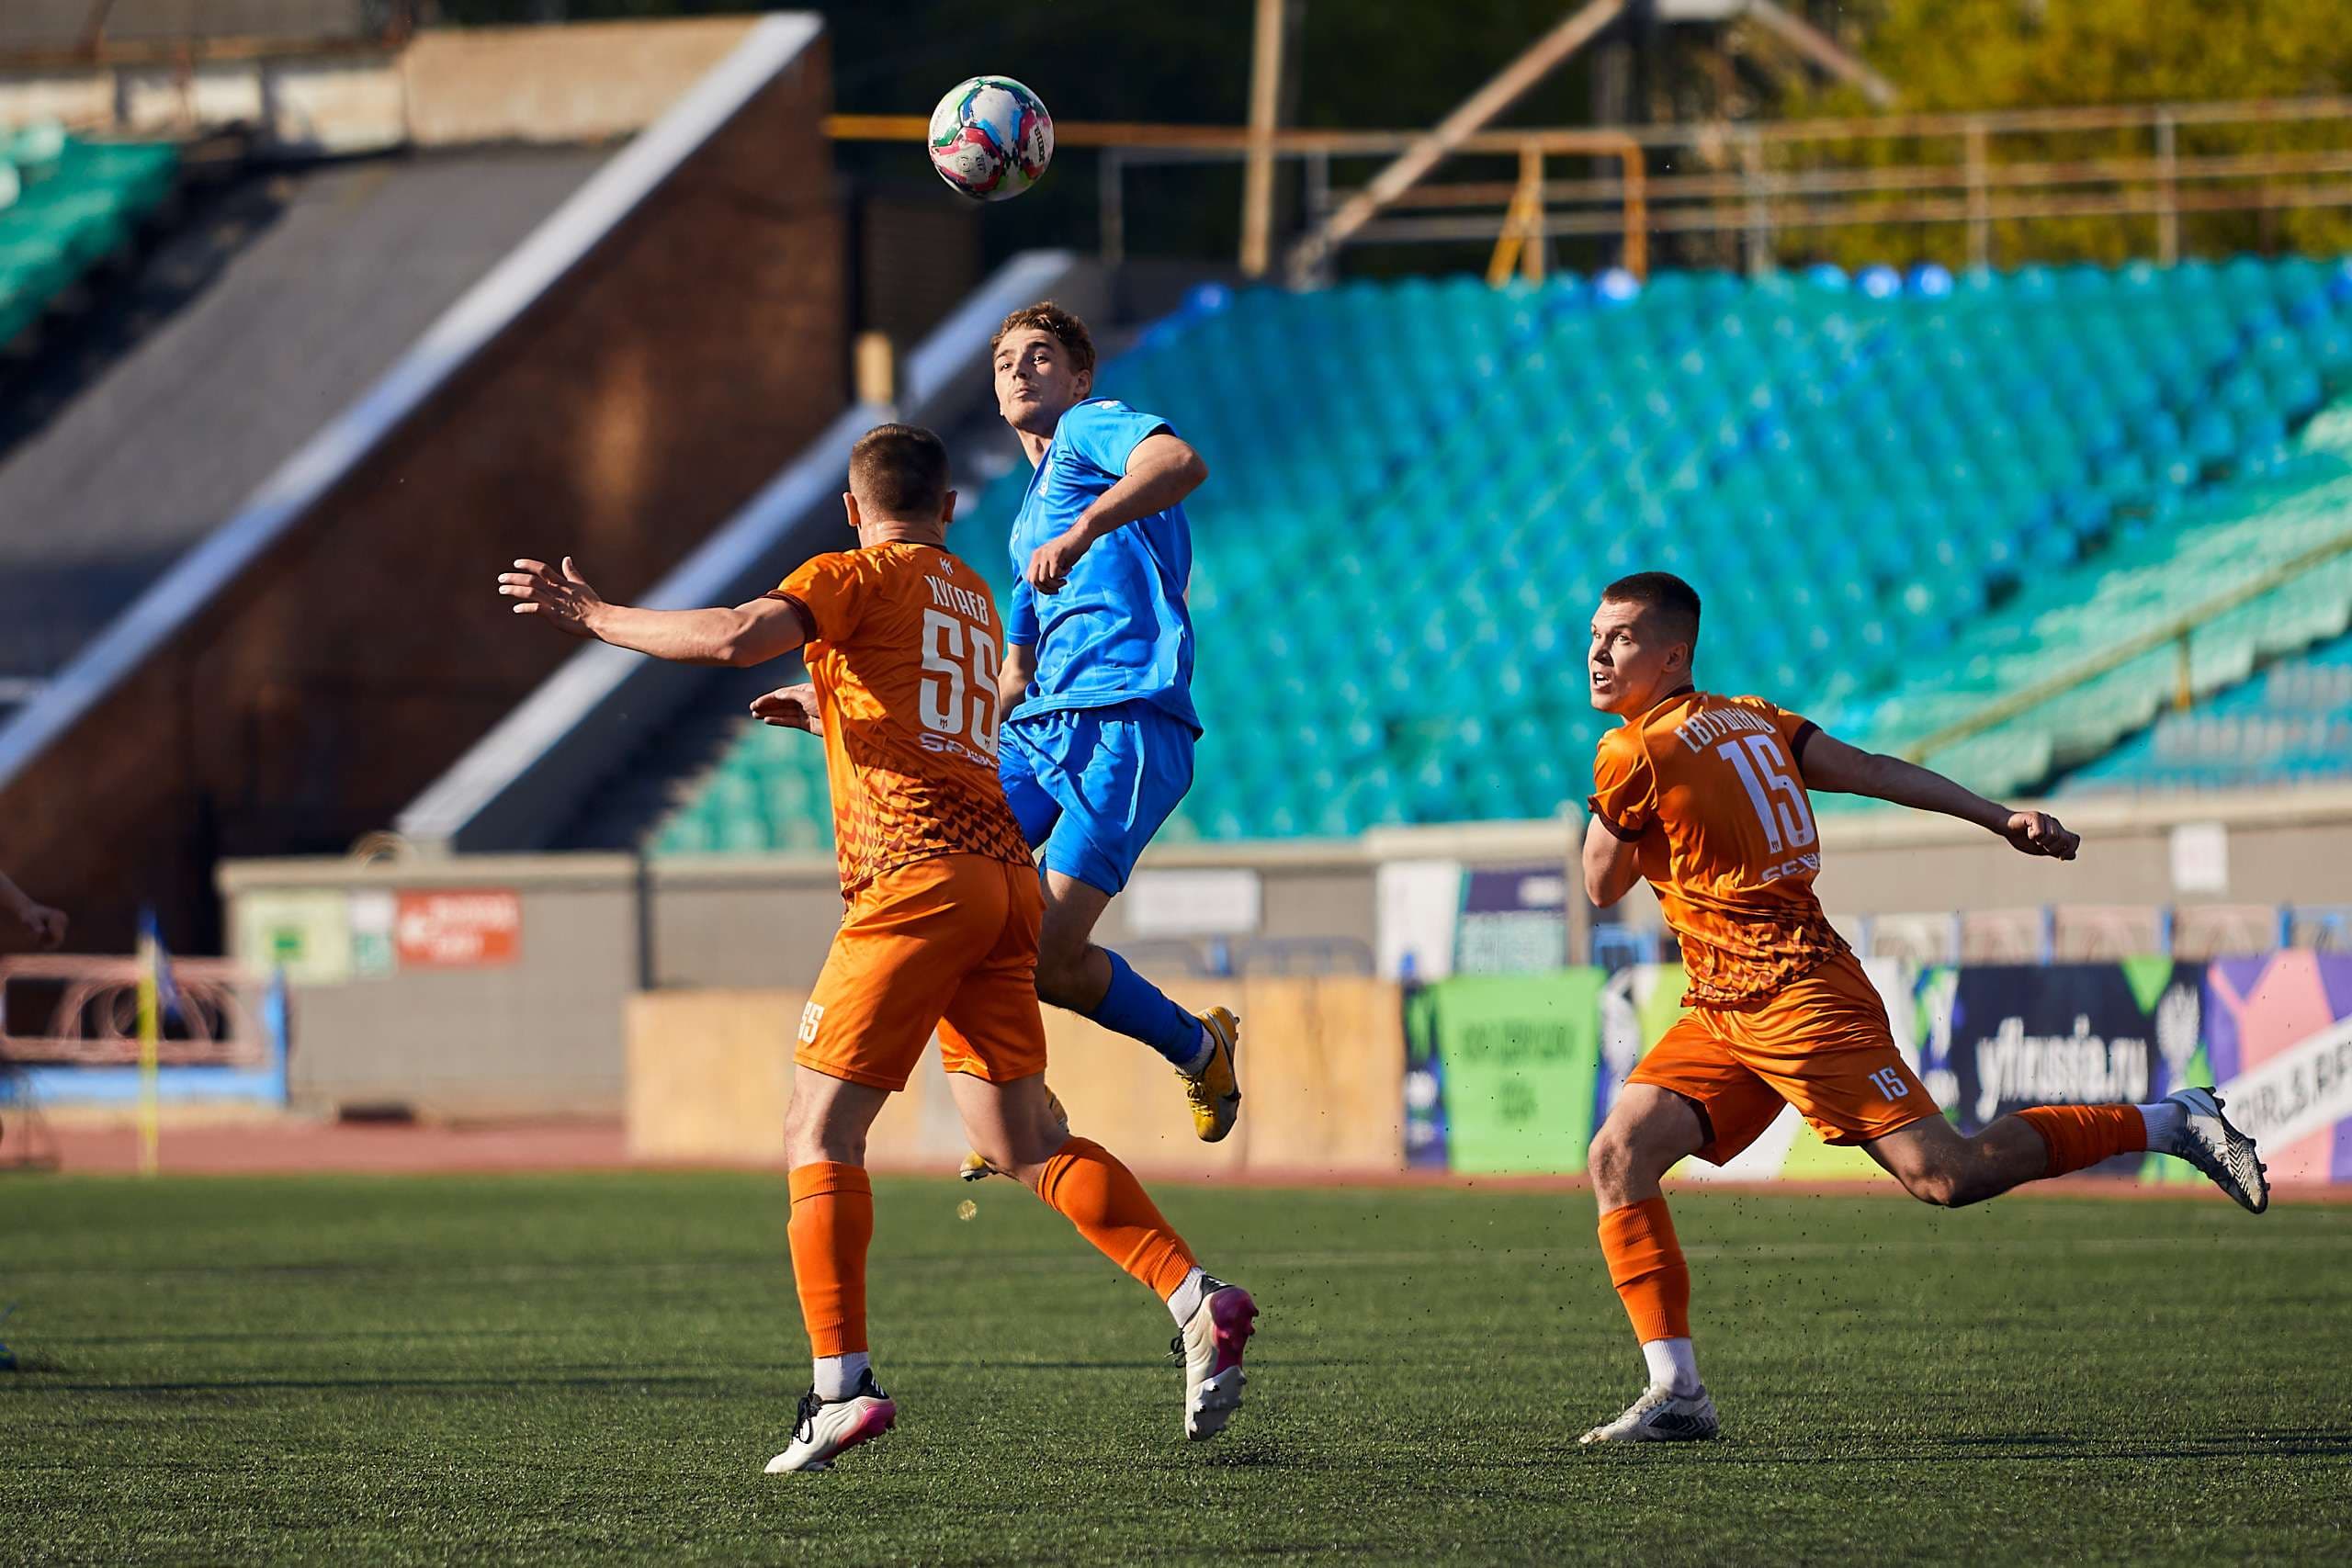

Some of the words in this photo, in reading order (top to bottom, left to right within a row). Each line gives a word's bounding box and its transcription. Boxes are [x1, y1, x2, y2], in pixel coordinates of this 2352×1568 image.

[923, 575, 989, 626] ХУГАЕВ
[920, 607, 1000, 757] 55
[1716, 734, 1815, 854] 15
[1868, 1066, 1909, 1101] 15
